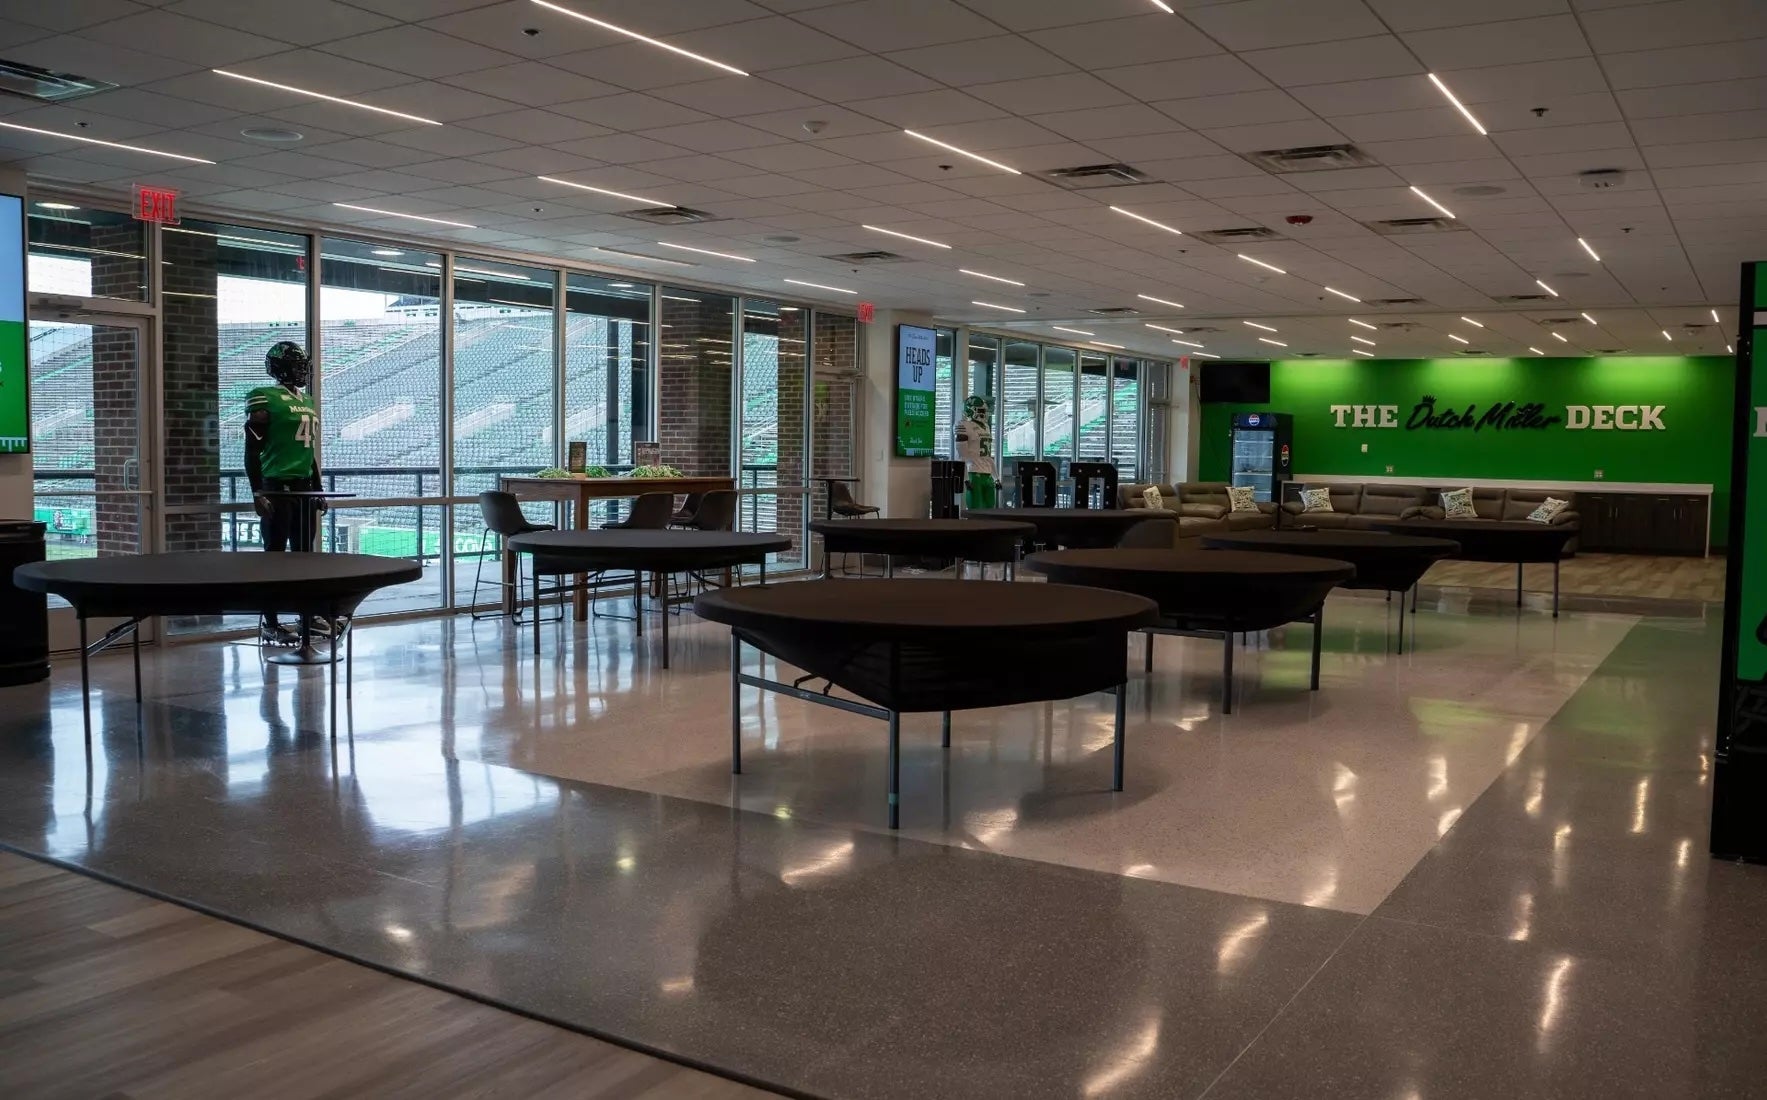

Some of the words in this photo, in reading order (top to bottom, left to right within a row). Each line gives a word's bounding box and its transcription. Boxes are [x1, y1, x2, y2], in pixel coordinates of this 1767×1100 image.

[141, 189, 175, 220] EXIT
[906, 347, 931, 366] HEADS
[912, 365, 923, 383] UP
[1330, 404, 1398, 428] THE
[1406, 402, 1476, 431] Dutch
[1474, 402, 1561, 432] Miller
[1565, 404, 1667, 430] DECK
